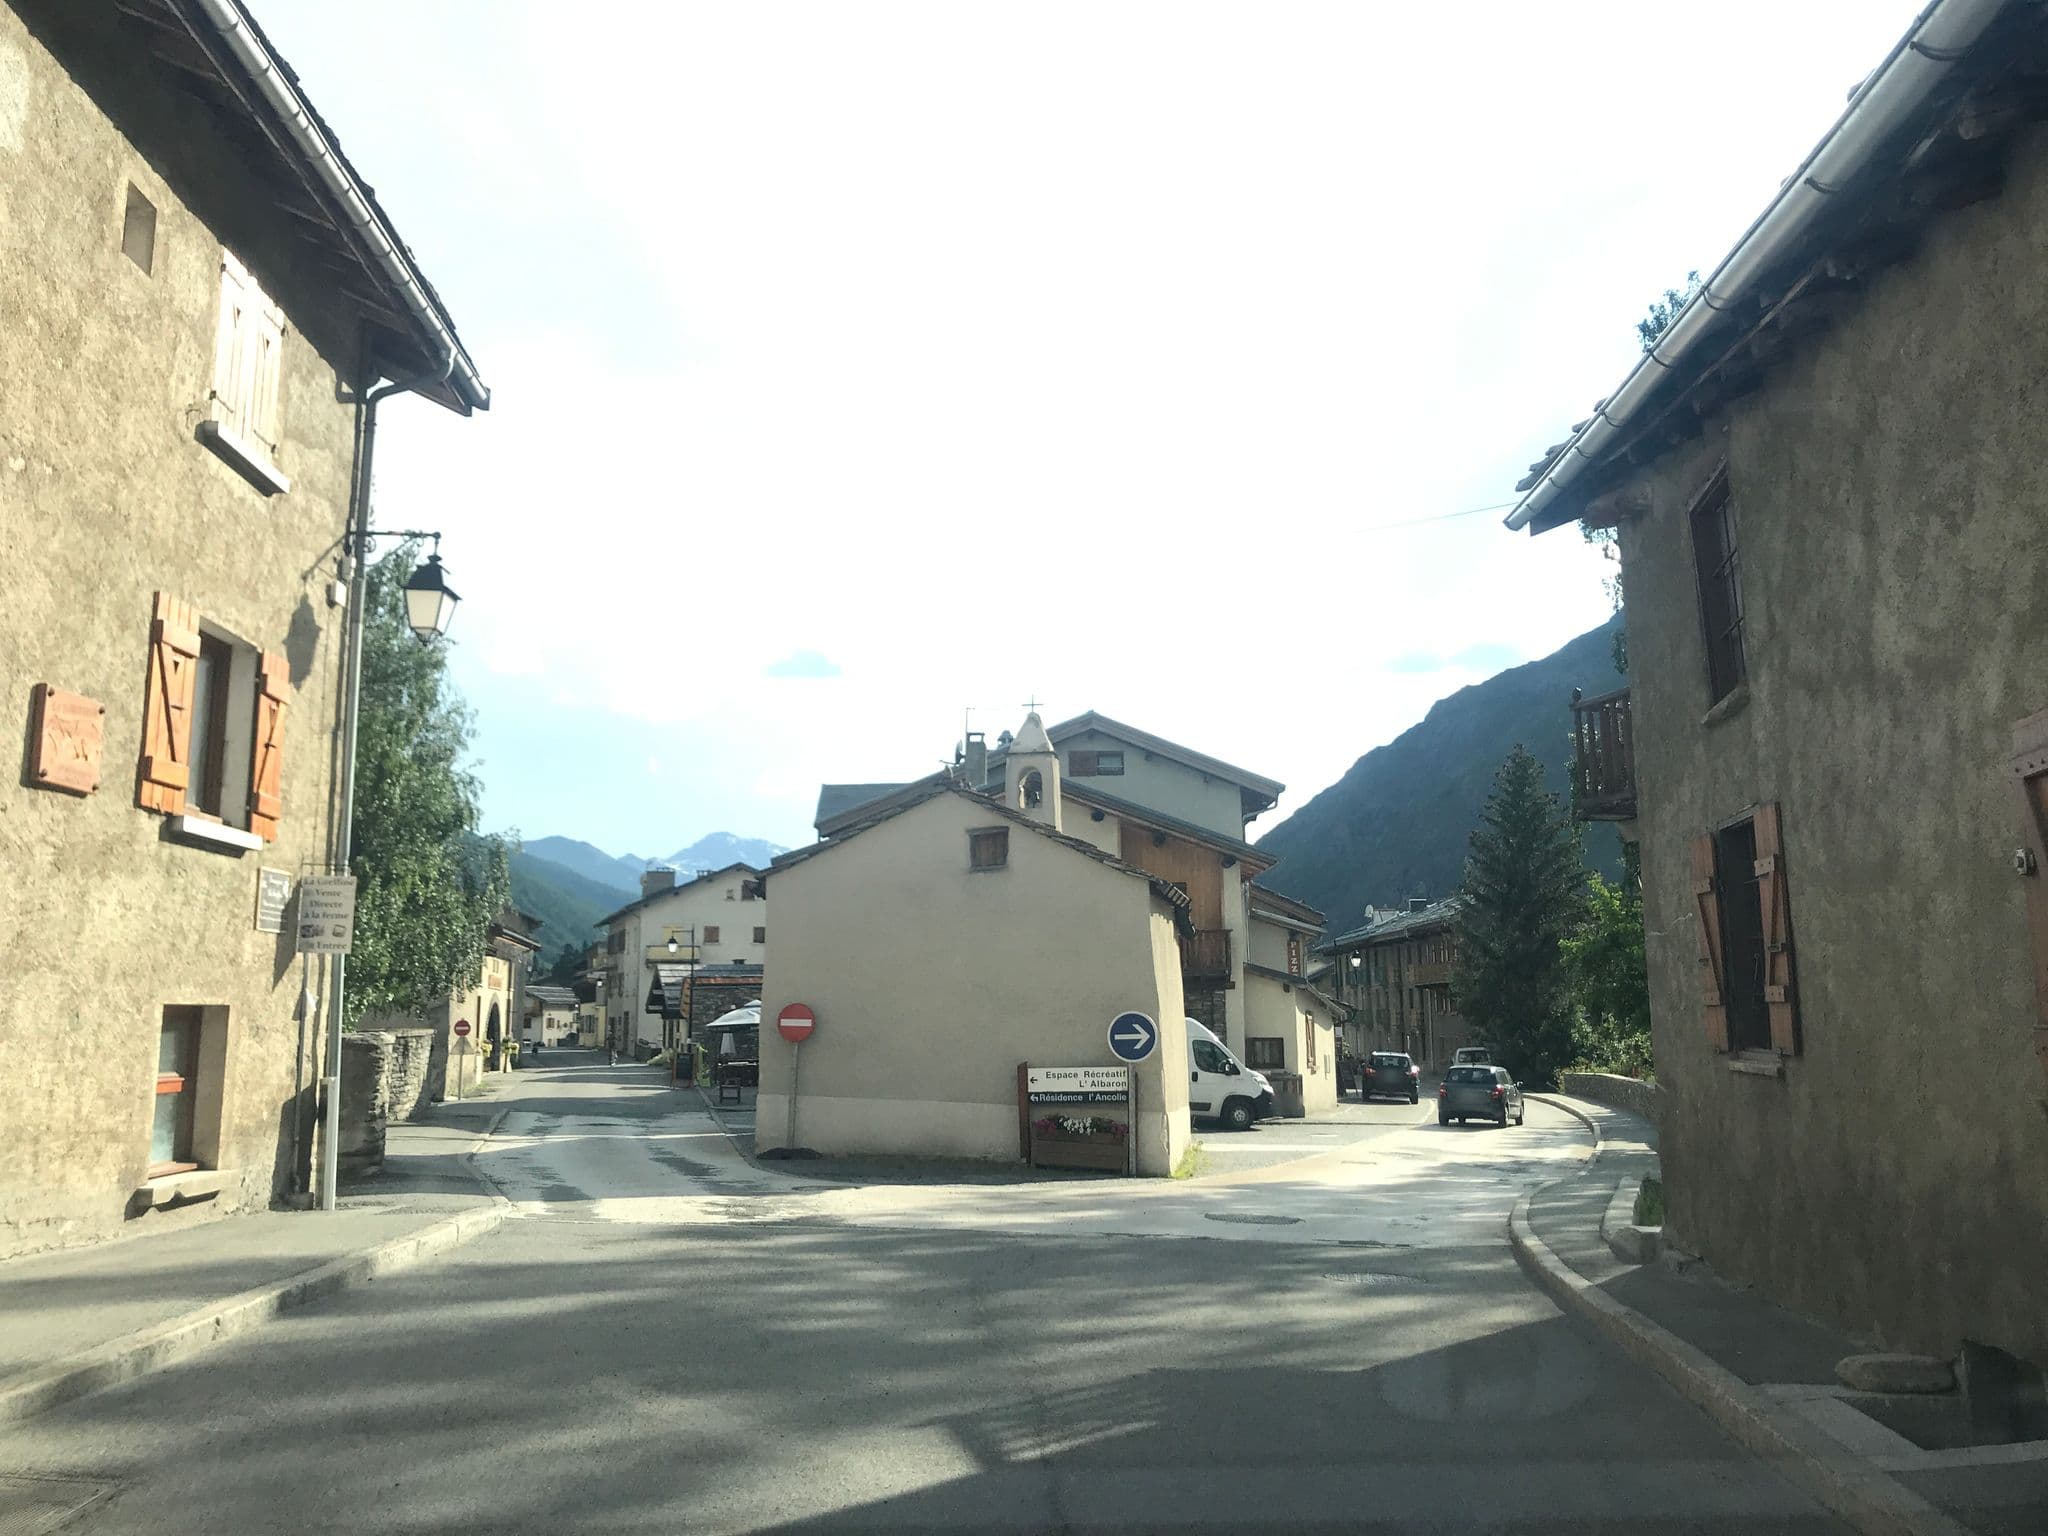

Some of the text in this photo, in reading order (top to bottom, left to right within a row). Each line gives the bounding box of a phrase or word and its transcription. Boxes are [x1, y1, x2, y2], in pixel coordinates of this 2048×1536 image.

[1045, 1070, 1127, 1081] Espace Récréatif
[1039, 1092, 1127, 1102] Résidence l'Ancolie
